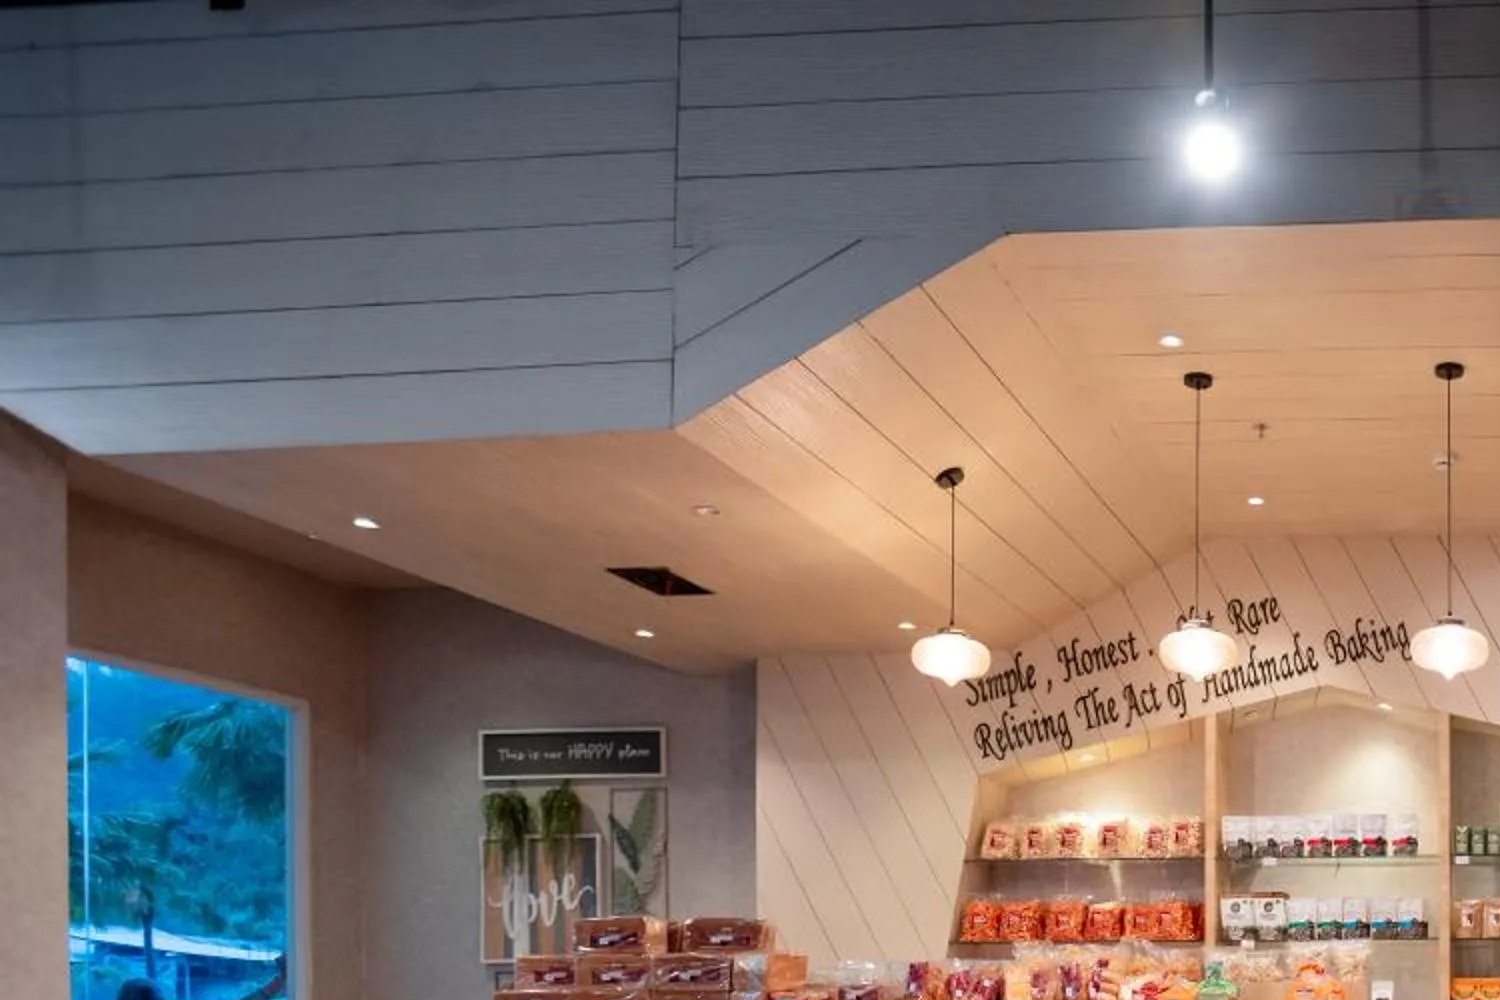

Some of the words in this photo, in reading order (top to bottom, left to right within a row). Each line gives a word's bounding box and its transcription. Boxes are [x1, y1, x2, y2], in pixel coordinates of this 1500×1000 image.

[965, 652, 1037, 708] Simple
[1057, 631, 1140, 683] Honest
[1227, 596, 1281, 636] Rare
[974, 709, 1073, 761] Reliving
[1075, 686, 1119, 731] The
[1125, 682, 1162, 729] Act
[1167, 673, 1186, 718] of
[1324, 617, 1412, 665] Baking
